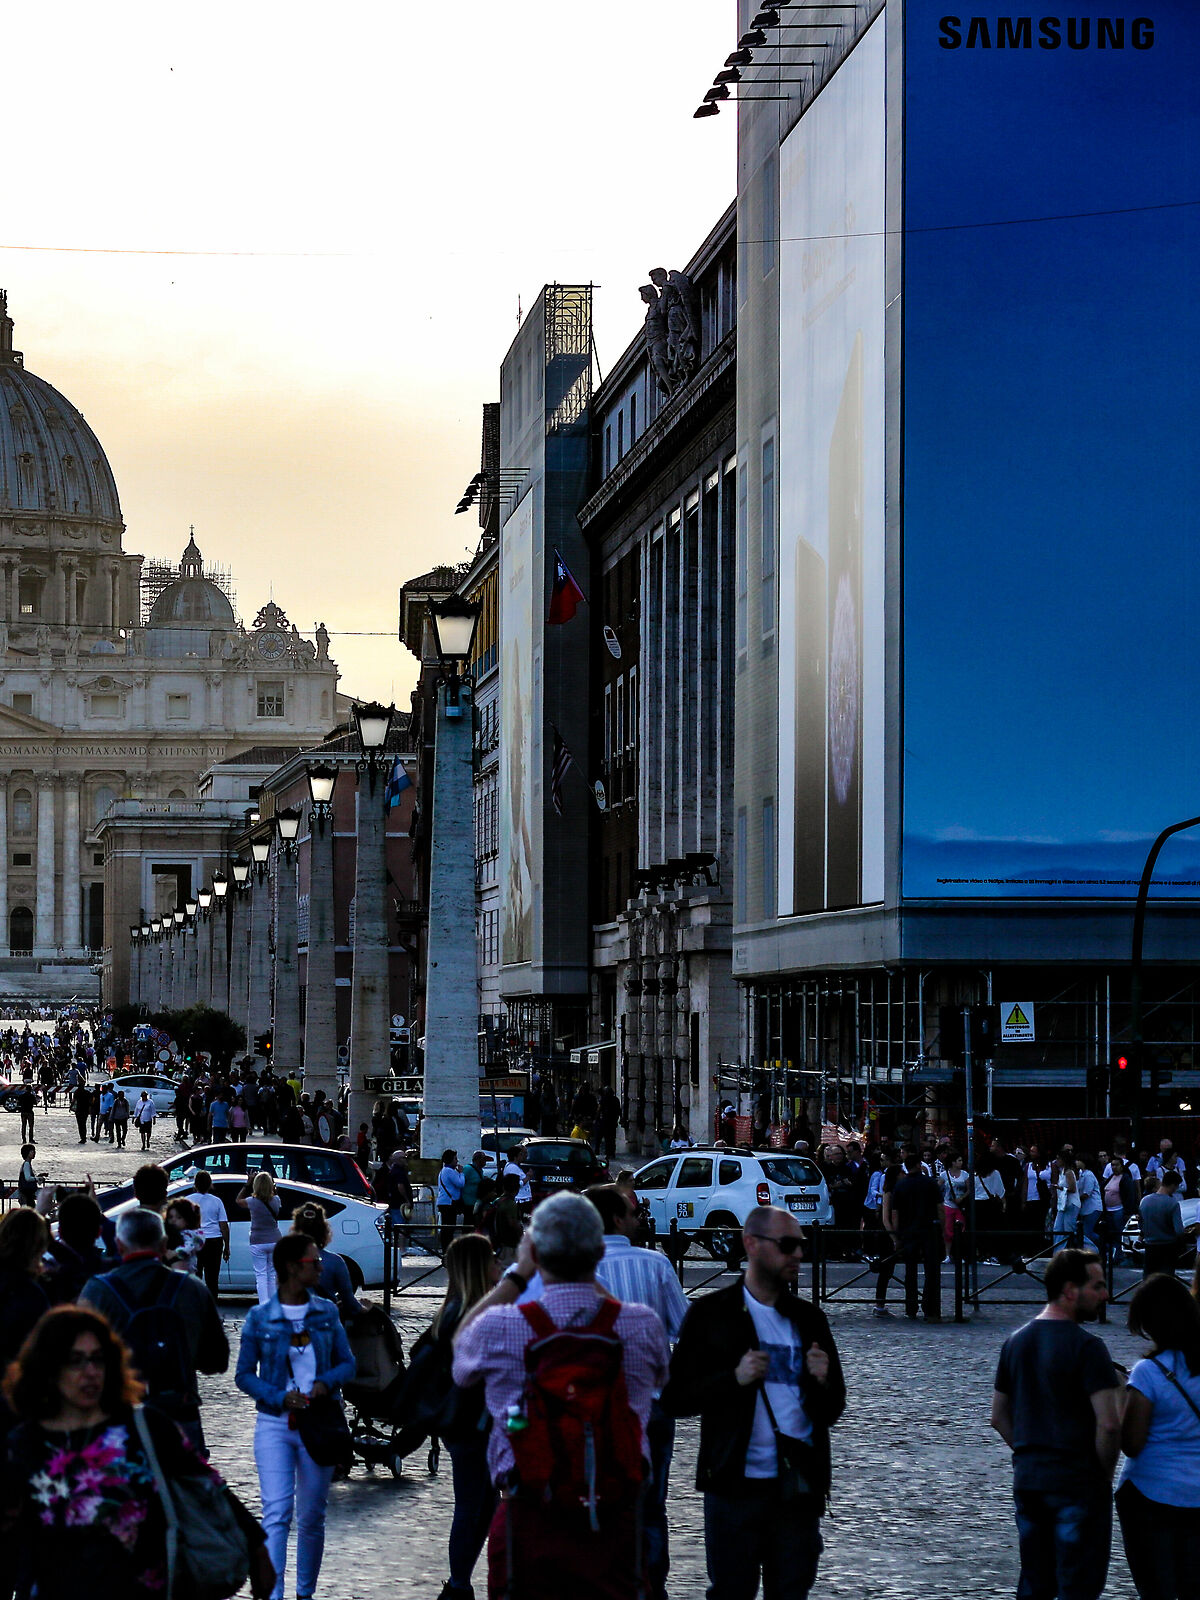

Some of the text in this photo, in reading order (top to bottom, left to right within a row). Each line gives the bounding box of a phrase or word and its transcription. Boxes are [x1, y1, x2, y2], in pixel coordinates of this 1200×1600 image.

[938, 16, 1155, 50] SAMSUNG
[56, 746, 84, 755] PONT
[86, 746, 110, 755] MAX
[176, 747, 205, 756] PONT
[208, 747, 225, 756] VII
[382, 1080, 423, 1092] GELA
[678, 1203, 687, 1211] 35
